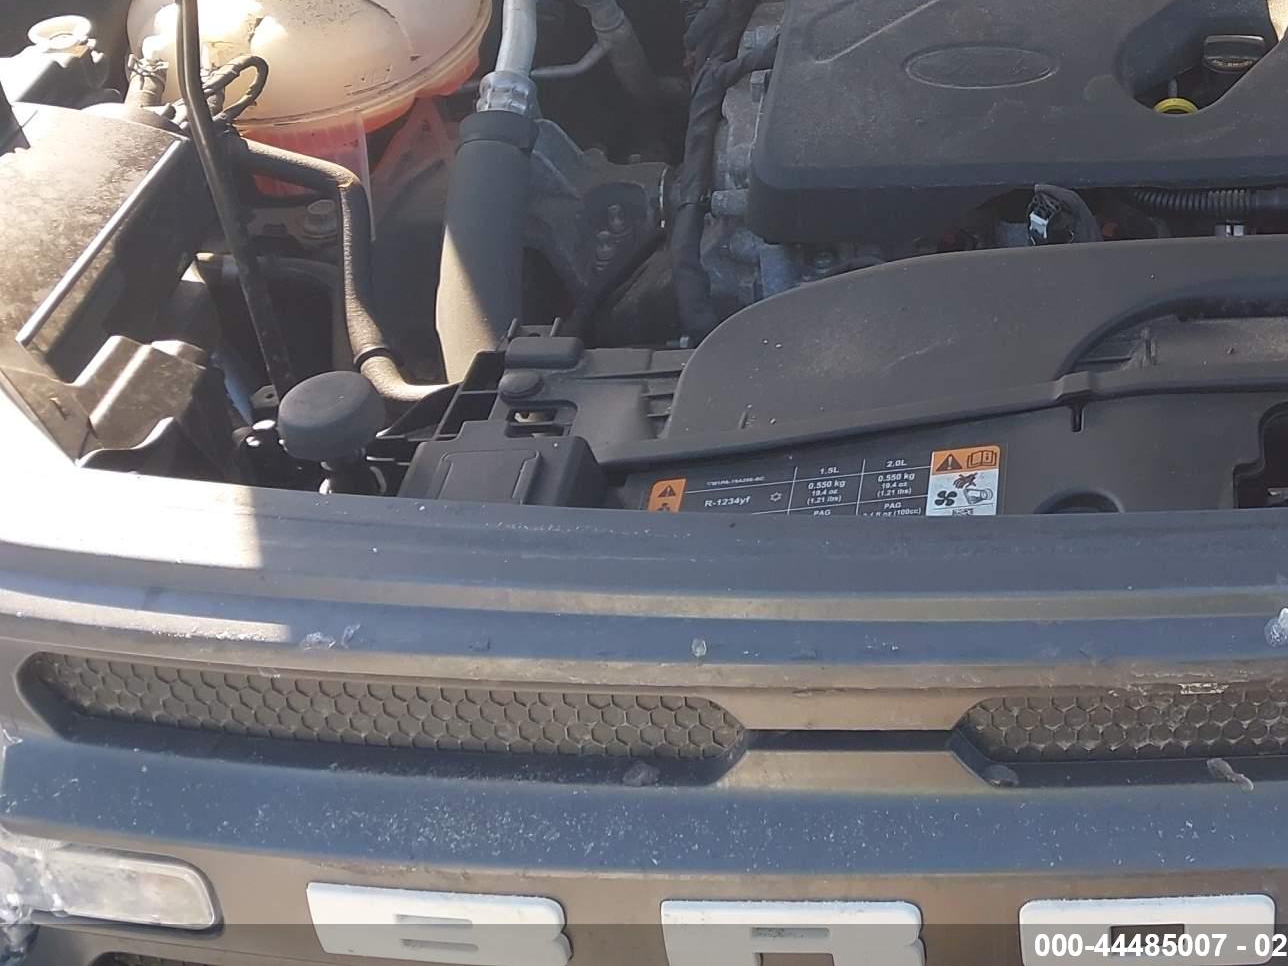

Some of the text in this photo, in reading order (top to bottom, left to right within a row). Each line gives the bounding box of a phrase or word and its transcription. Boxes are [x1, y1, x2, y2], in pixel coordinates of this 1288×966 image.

[886, 459, 907, 468] 2.0L
[877, 472, 916, 483] 0.550 kg
[808, 479, 846, 490] 0.550 kg
[704, 495, 751, 508] R-1234yf
